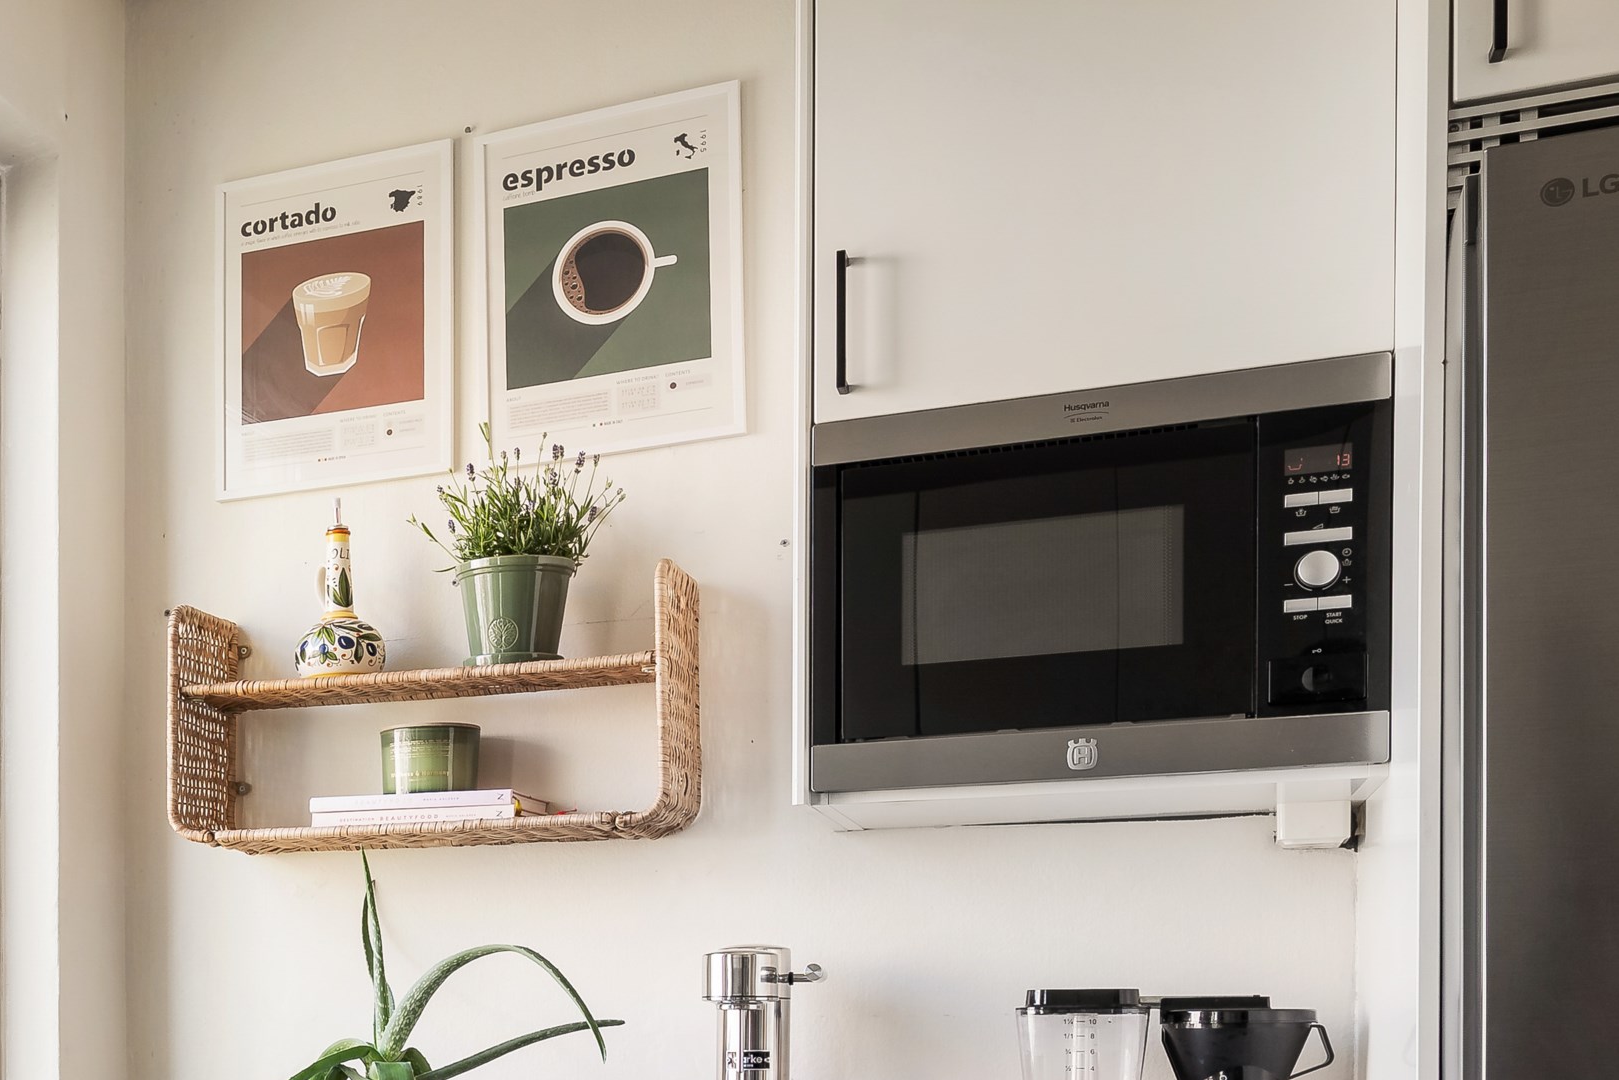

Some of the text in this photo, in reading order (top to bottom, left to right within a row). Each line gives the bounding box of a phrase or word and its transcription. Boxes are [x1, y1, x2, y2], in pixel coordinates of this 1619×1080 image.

[699, 129, 707, 153] 1995
[502, 149, 636, 192] espresso
[1582, 173, 1619, 198] LG
[241, 202, 337, 237] cortado
[1063, 401, 1110, 412] Husqvarna
[380, 814, 438, 822] BEAUTYFOOD
